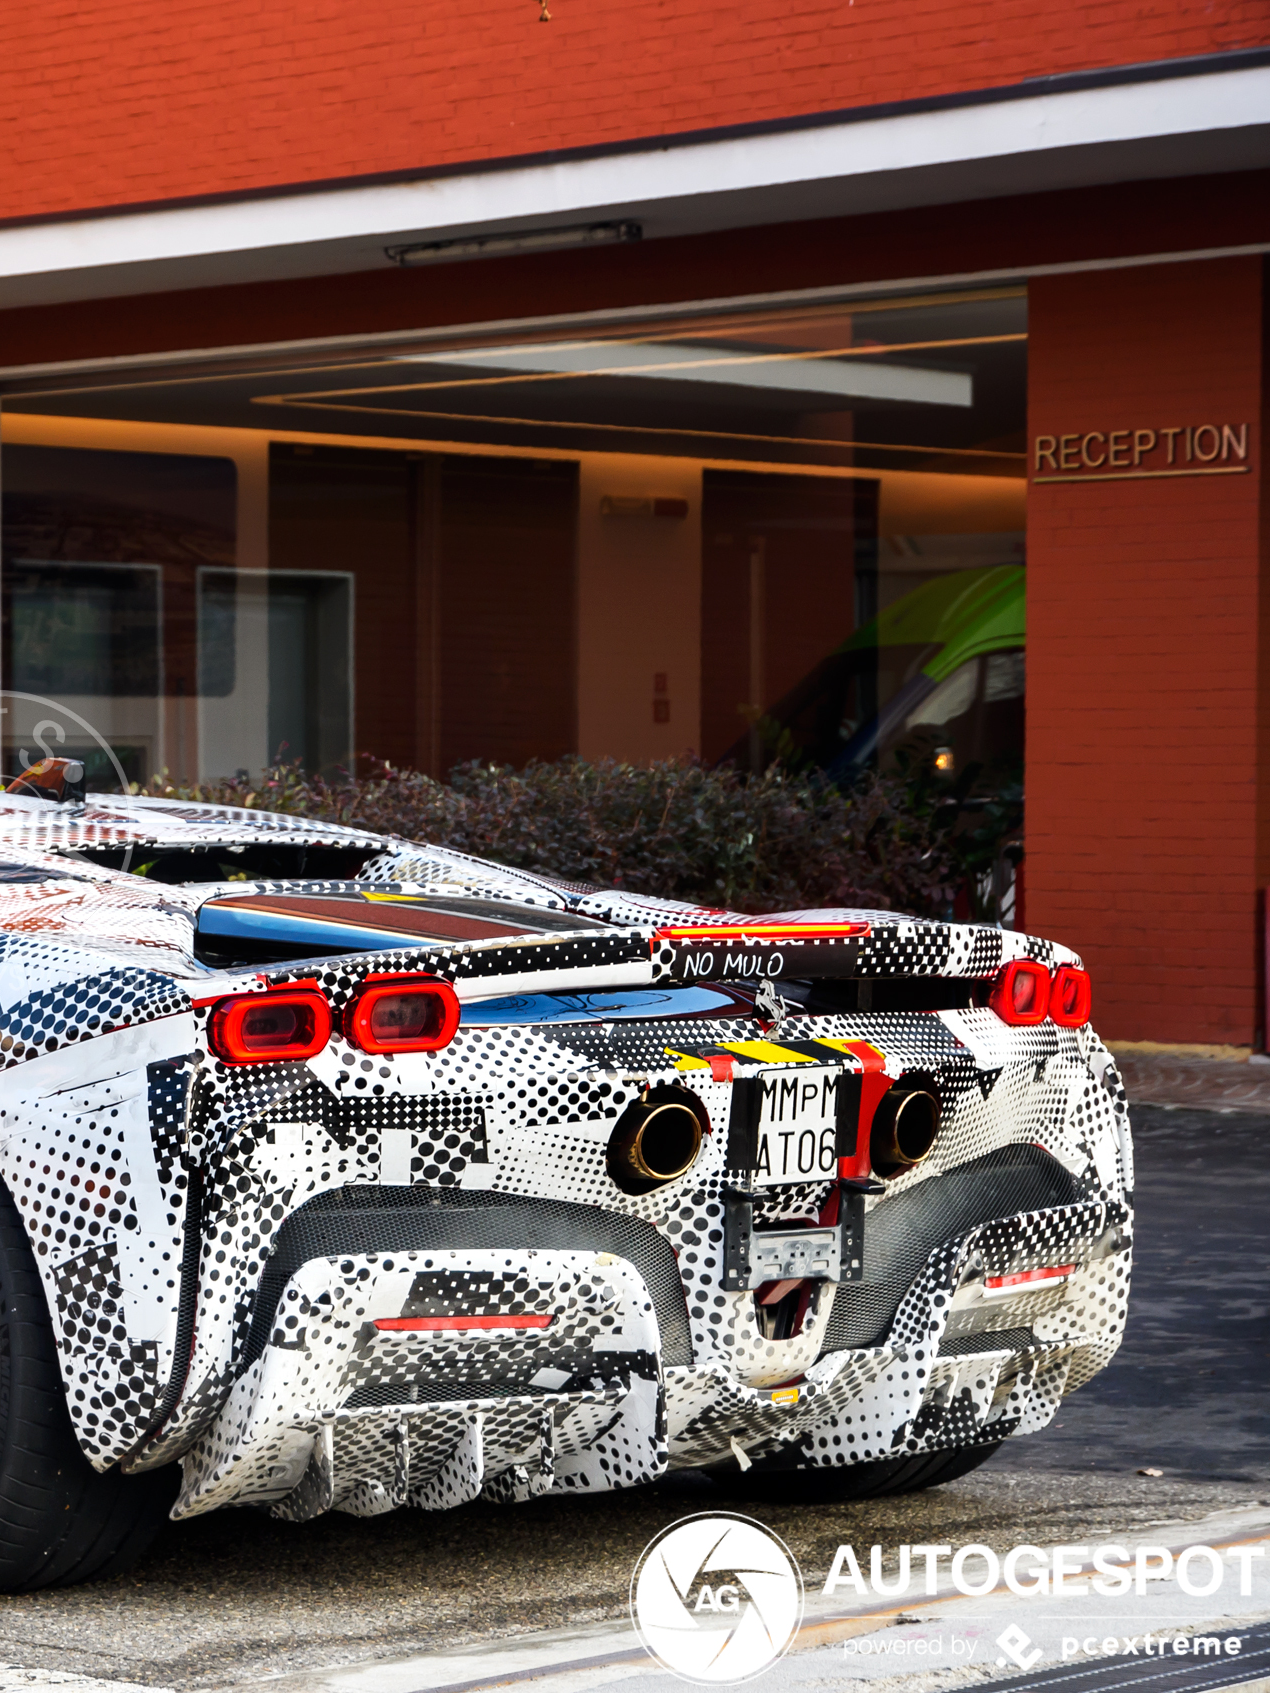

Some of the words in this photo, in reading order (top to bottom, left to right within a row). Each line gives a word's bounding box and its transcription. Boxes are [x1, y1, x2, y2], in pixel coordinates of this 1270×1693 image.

[1034, 423, 1248, 470] RECEPTION
[683, 951, 714, 978] NO
[723, 952, 784, 977] MULO
